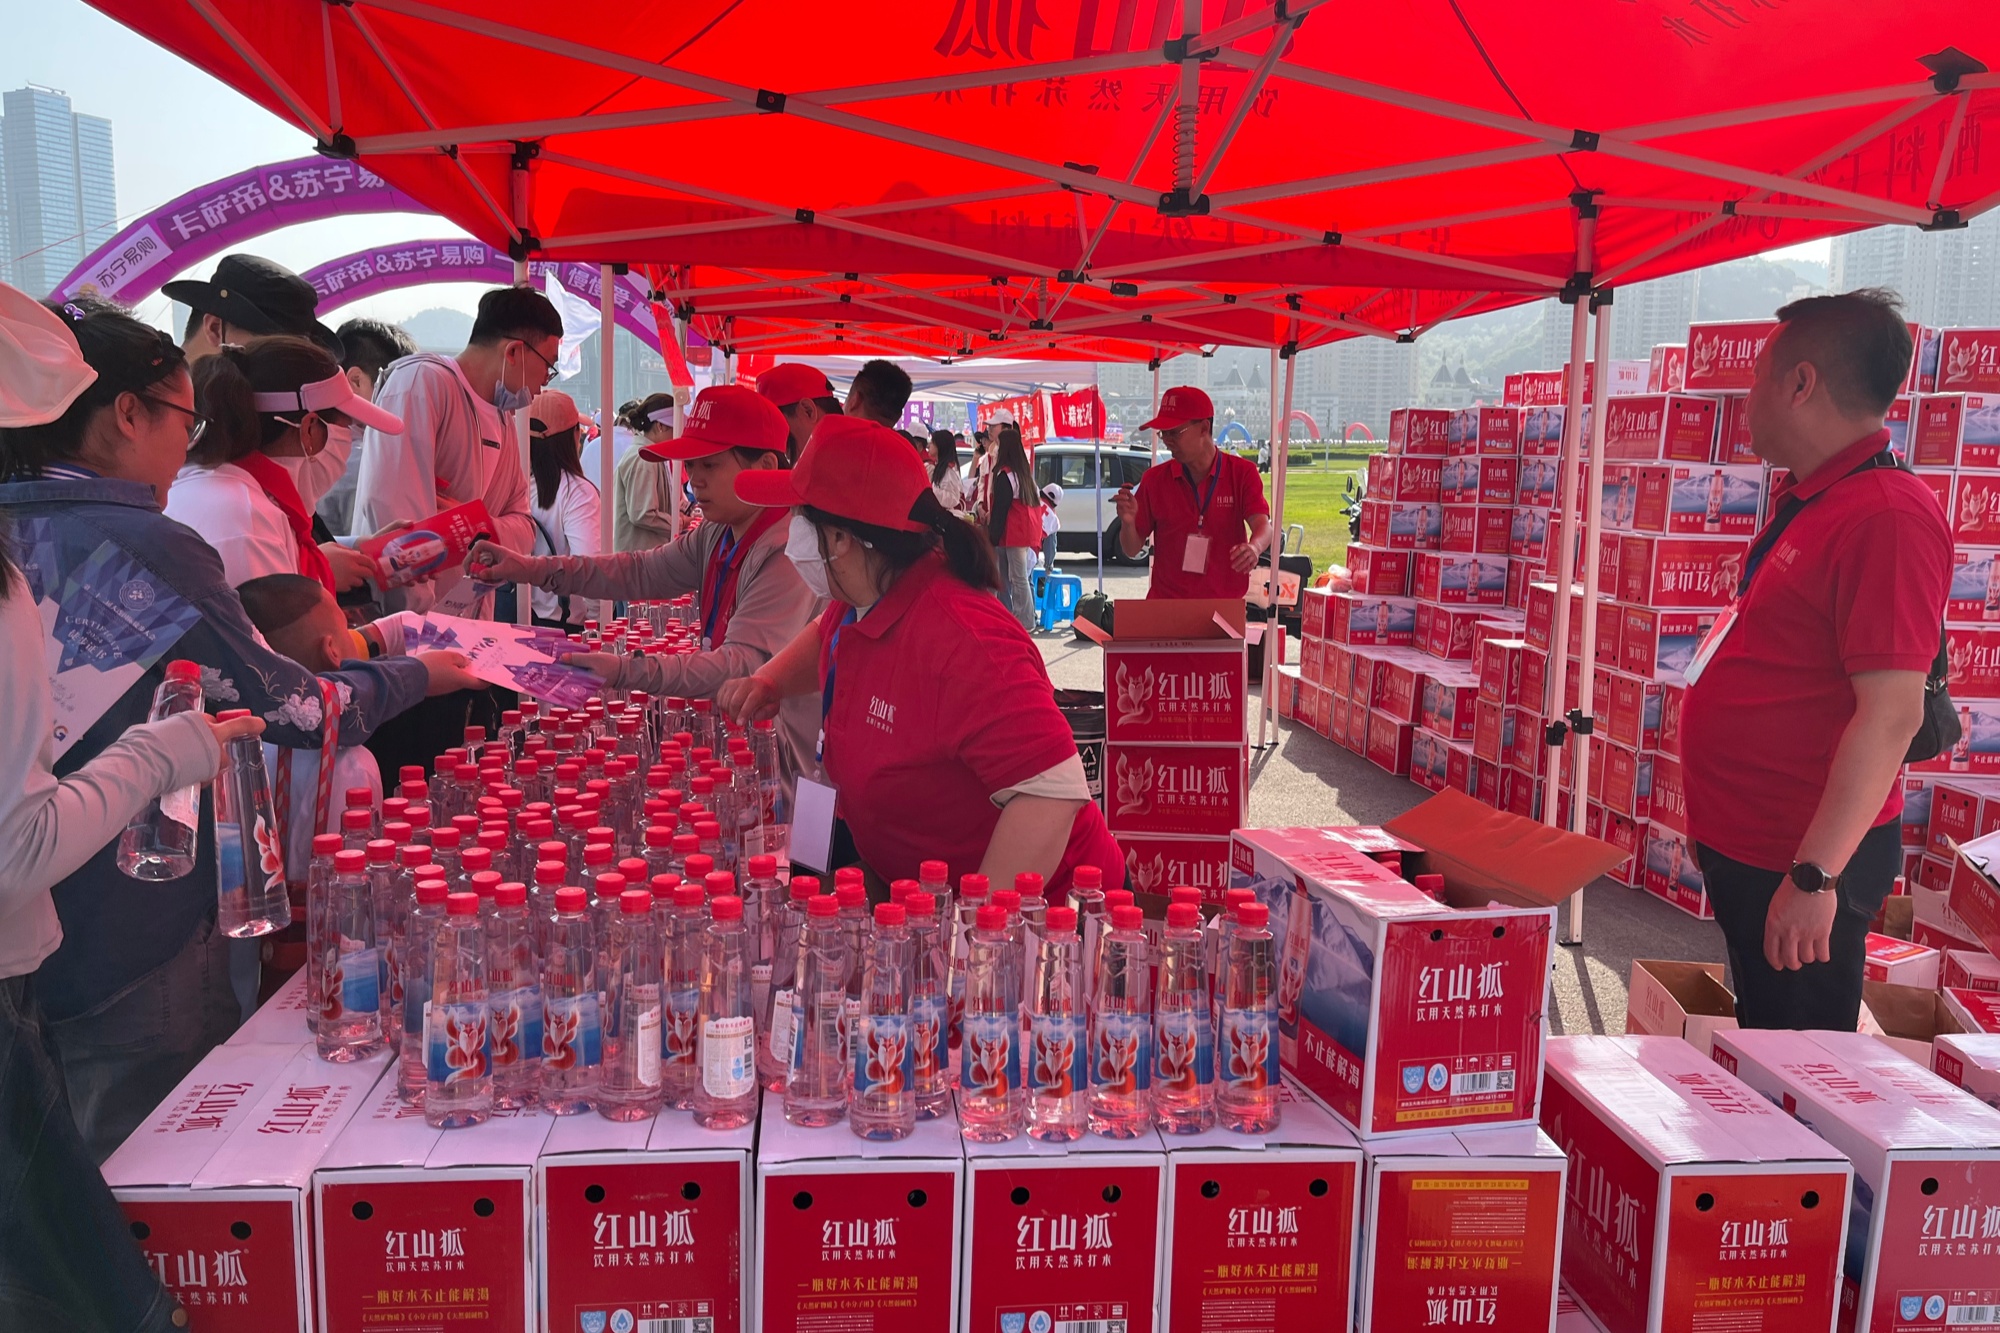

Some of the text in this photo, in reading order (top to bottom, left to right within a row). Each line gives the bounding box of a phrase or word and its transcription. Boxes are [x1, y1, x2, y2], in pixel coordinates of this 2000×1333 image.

[95, 234, 158, 289] 苏宁易购
[1662, 571, 1711, 592] 红山狐
[1158, 671, 1231, 701] 红山狐
[1158, 702, 1231, 713] 饮用天然苏打水
[1157, 764, 1229, 793] 红山狐
[1157, 794, 1229, 806] 饮用天然苏打水
[1418, 962, 1504, 1004] 红山狐
[1416, 1004, 1502, 1022] 饮用天然苏打水
[1305, 1029, 1360, 1089] 不止能解渴
[1797, 1063, 1887, 1105] 红山狐
[176, 1082, 254, 1133] 红山狐
[257, 1085, 332, 1134] 红山狐
[594, 1209, 695, 1250] 红山狐
[1016, 1212, 1113, 1252] 红山狐
[1228, 1206, 1298, 1235] 红山狐
[1720, 1218, 1788, 1247] 红山狐
[386, 1228, 465, 1259] 红山狐
[822, 1218, 897, 1248] 红山狐
[1227, 1237, 1298, 1248] 饮用天然苏打水
[386, 1261, 465, 1272] 饮用天然苏打水
[593, 1251, 695, 1268] 饮用天然苏打水
[821, 1250, 896, 1261] 饮用天然苏打水
[1015, 1254, 1111, 1270] 饮用天然苏打水
[1719, 1249, 1787, 1260] 饮用天然苏打水
[1203, 1263, 1318, 1278] 一瓶好水不止能解渴
[1696, 1274, 1805, 1290] 一瓶好水不止能解渴
[362, 1288, 489, 1304] 一瓶好水不止能解渴
[797, 1276, 918, 1292] 一瓶好水不止能解渴
[174, 1292, 249, 1305] 天然苏打水
[1426, 1298, 1497, 1325] 红山狐
